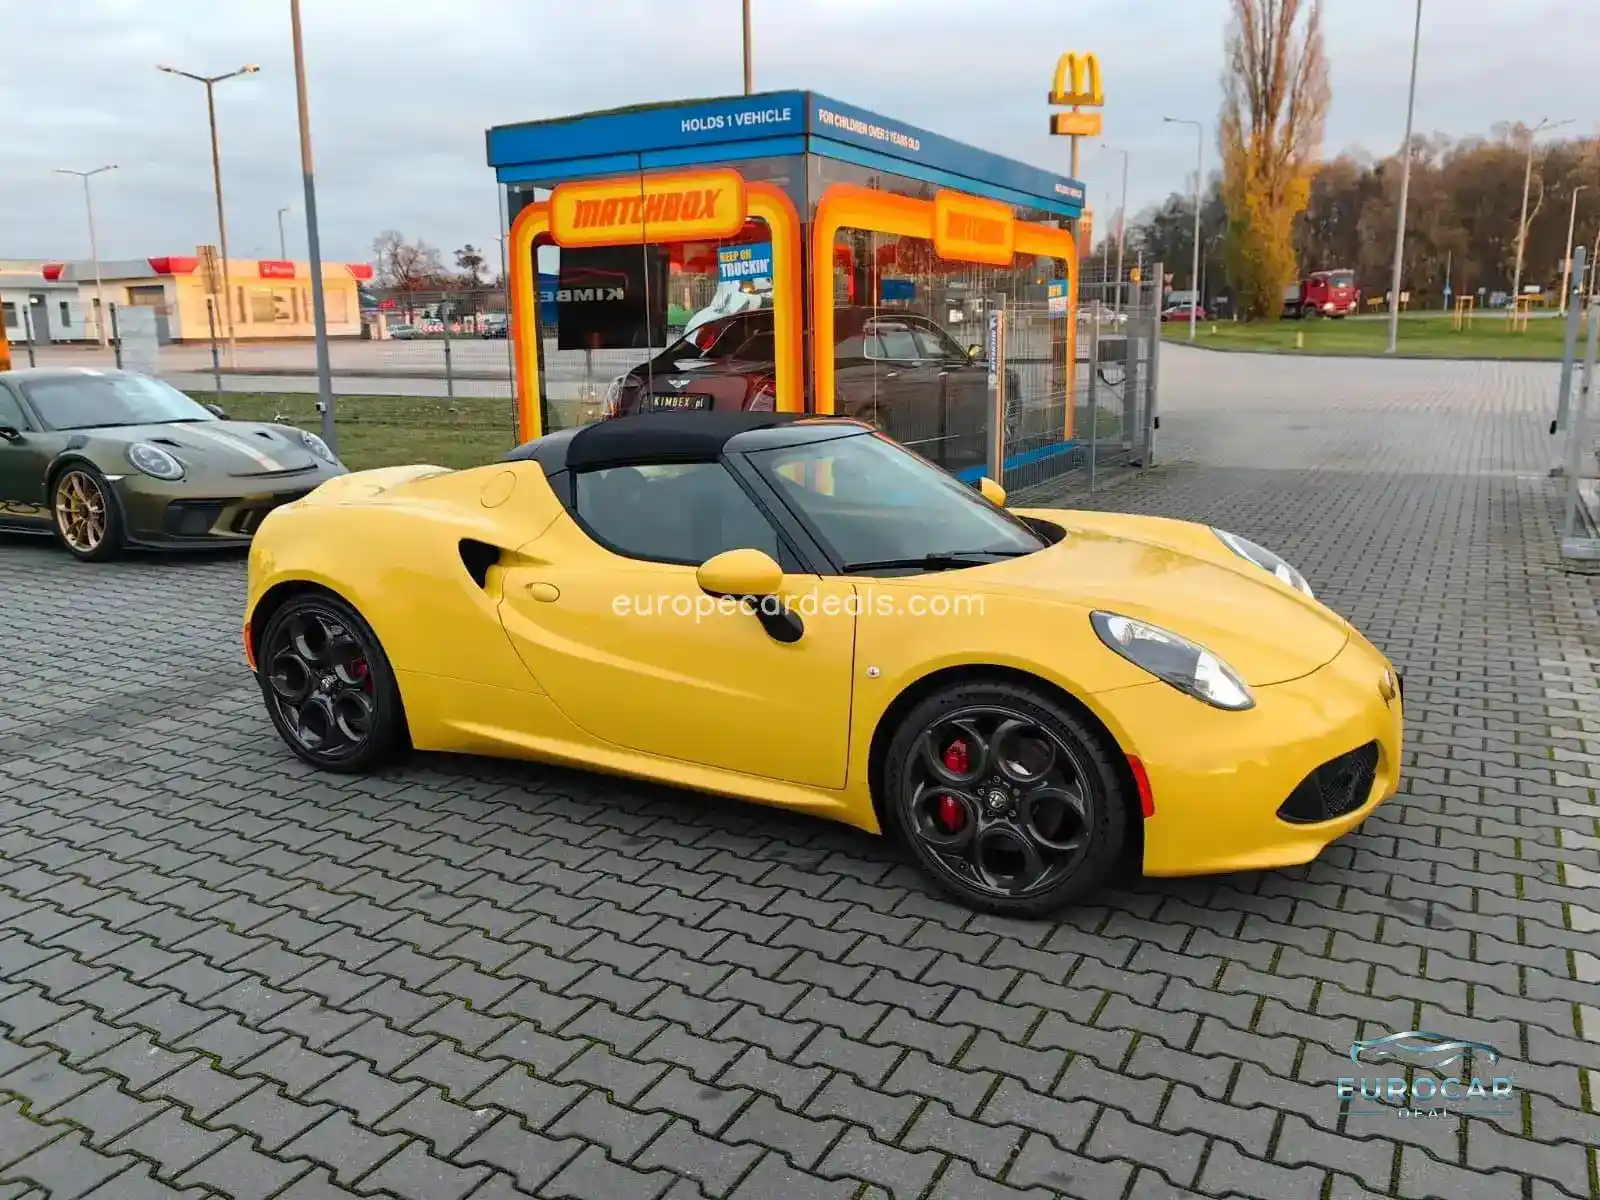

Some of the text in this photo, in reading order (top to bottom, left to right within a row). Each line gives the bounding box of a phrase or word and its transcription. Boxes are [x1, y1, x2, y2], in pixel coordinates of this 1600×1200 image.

[681, 107, 792, 132] HOLDS 1 VEHICLE
[818, 108, 834, 125] FOR
[835, 113, 868, 135] CHILDREN
[868, 123, 885, 140] OVER
[890, 130, 908, 148] YEARS
[908, 136, 920, 151] OLD
[573, 189, 723, 229] MATCHBOX
